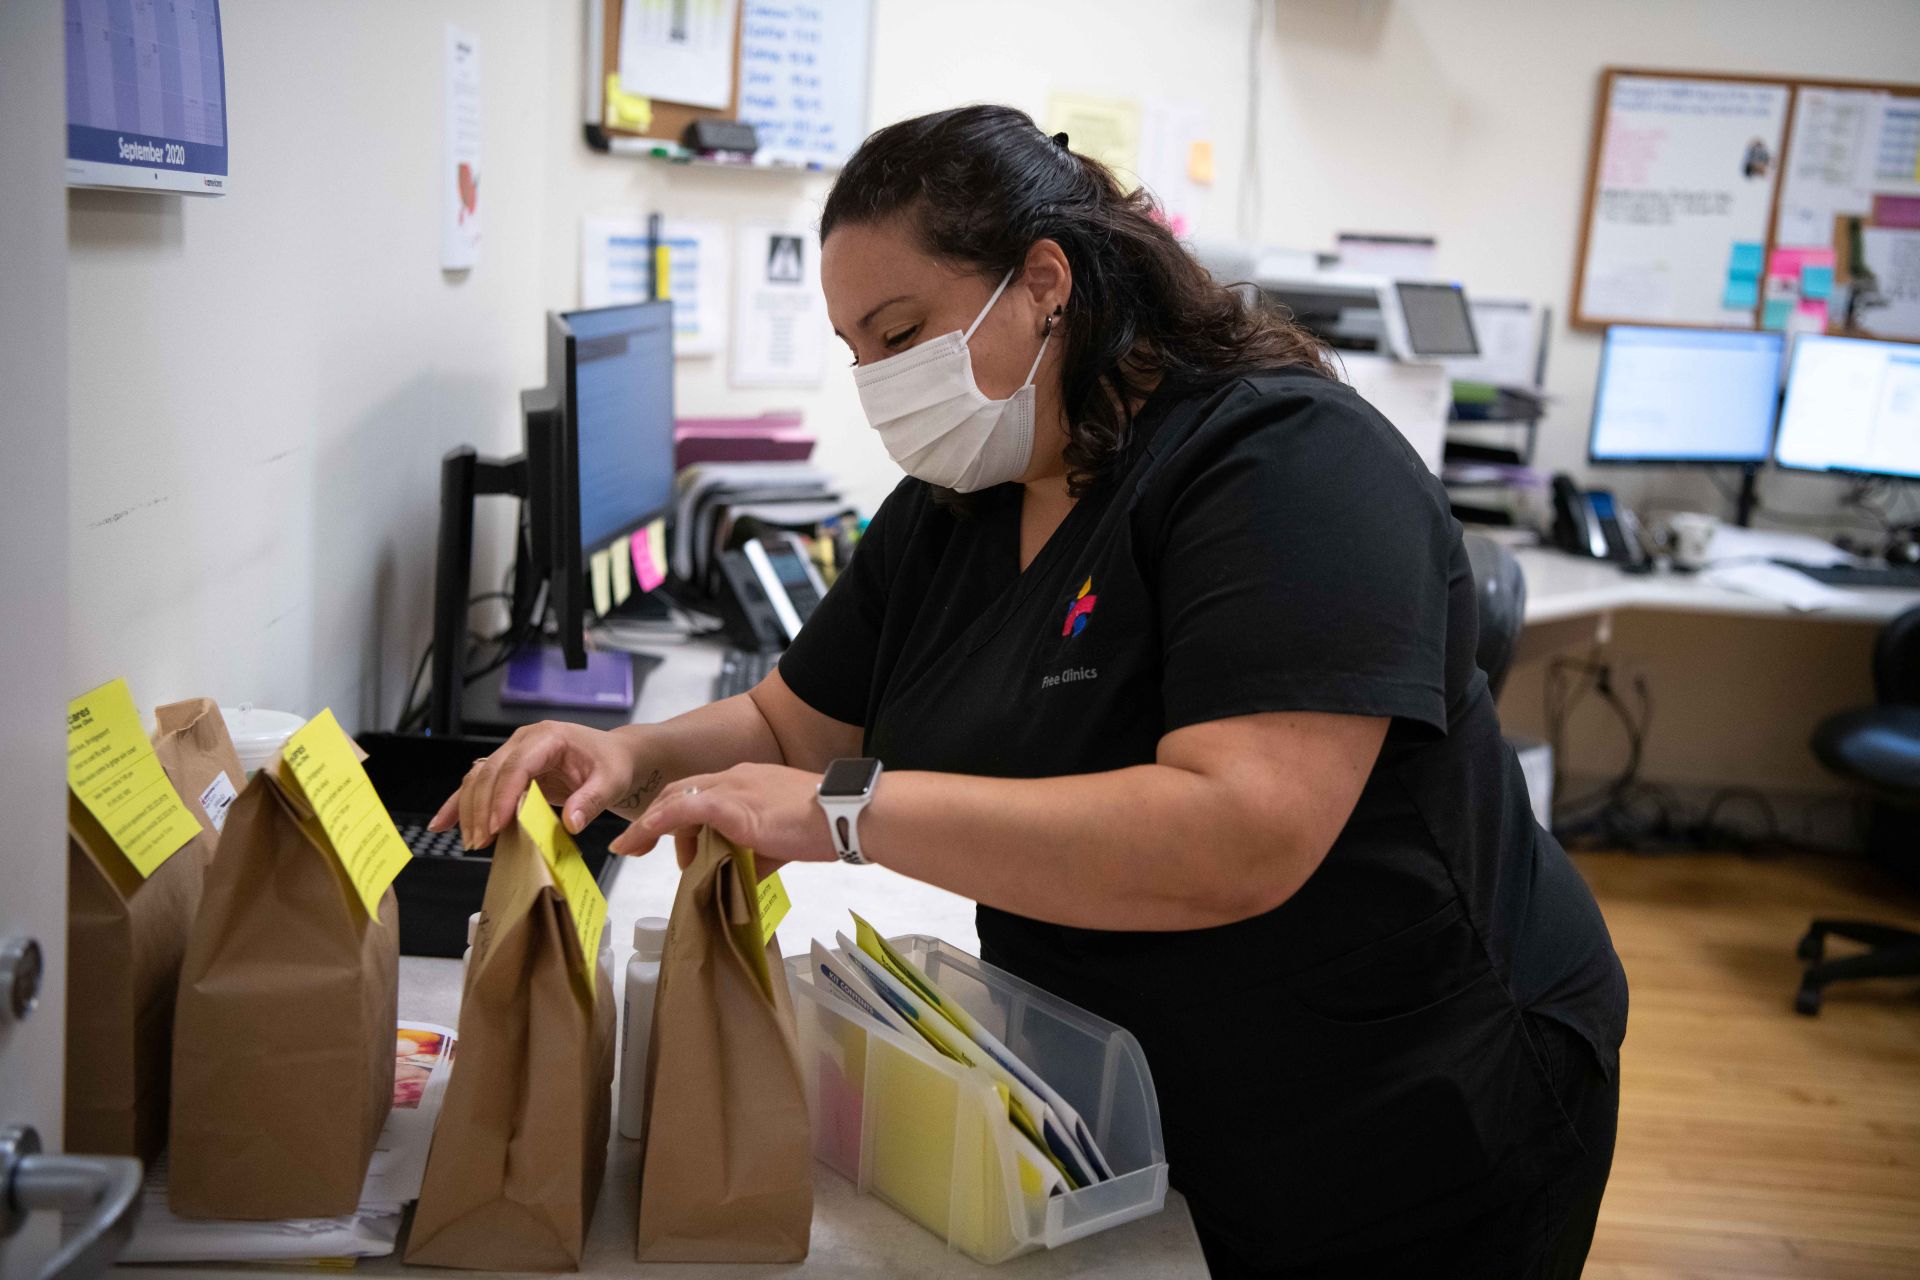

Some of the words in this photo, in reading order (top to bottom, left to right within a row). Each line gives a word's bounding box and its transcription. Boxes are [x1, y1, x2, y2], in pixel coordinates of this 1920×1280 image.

[118, 137, 164, 163] September
[165, 143, 185, 165] 2020
[1042, 675, 1060, 688] Free
[1062, 667, 1097, 682] Clinics
[829, 971, 840, 985] KIT
[840, 981, 874, 1015] CONTENTS
